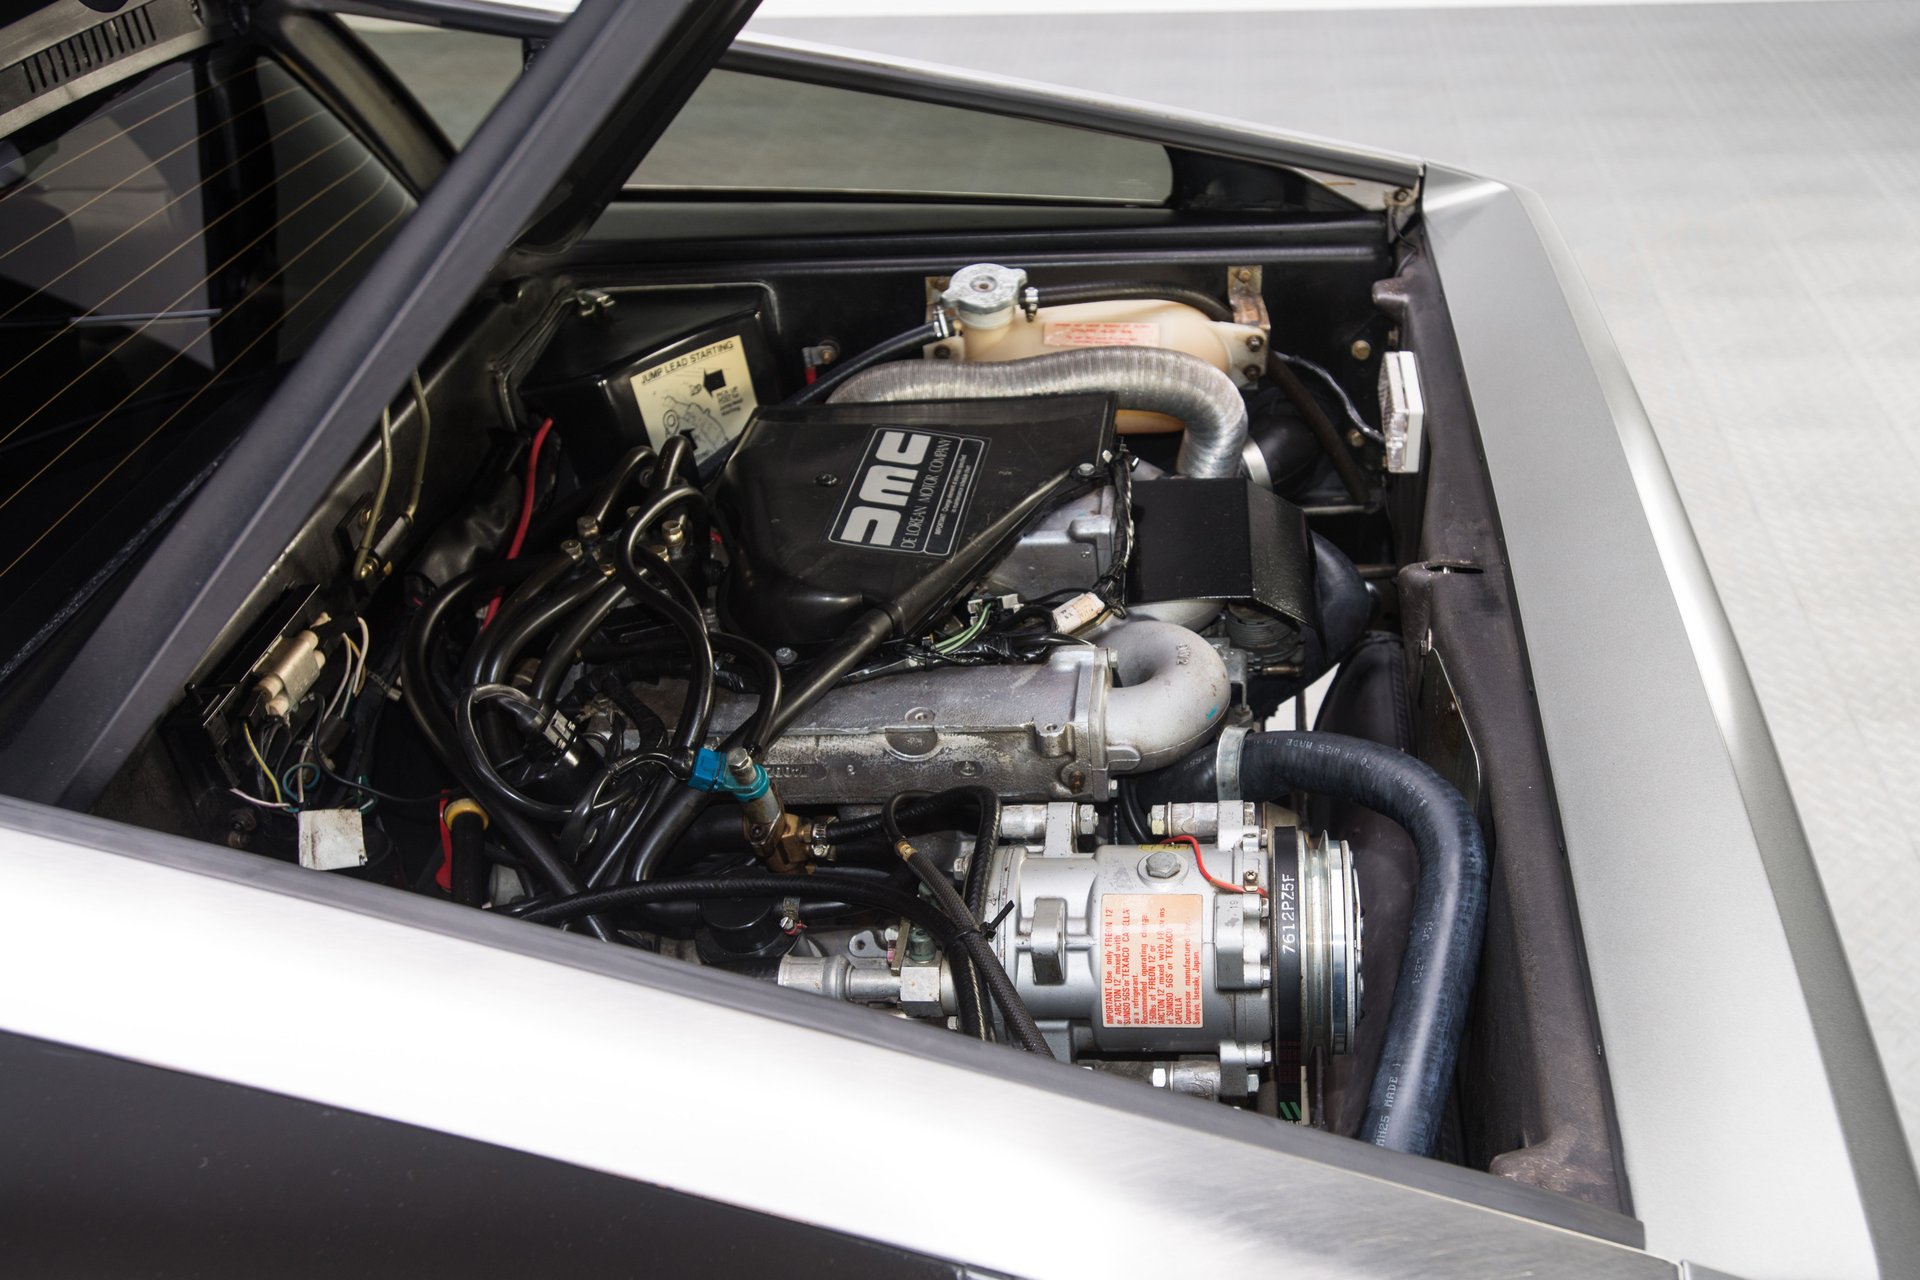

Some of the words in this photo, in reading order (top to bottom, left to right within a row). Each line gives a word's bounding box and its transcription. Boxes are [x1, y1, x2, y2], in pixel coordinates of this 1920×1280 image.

[641, 369, 662, 384] JUMP
[663, 358, 688, 373] LEAD
[691, 341, 734, 363] STARTING
[929, 438, 951, 472] COMPANY
[840, 431, 931, 546] DMC
[917, 475, 938, 502] MOTOR
[905, 506, 927, 536] LOREAN
[901, 537, 916, 549] DE
[1286, 738, 1312, 749] MADE
[1282, 873, 1296, 954] 7612PZ5F
[1105, 951, 1113, 964] only
[1140, 944, 1148, 976] operating
[1140, 982, 1148, 1024] Recommended
[1184, 991, 1193, 1024] Compressor
[1376, 1115, 1389, 1147] MH25
[1384, 1076, 1398, 1108] MADE
